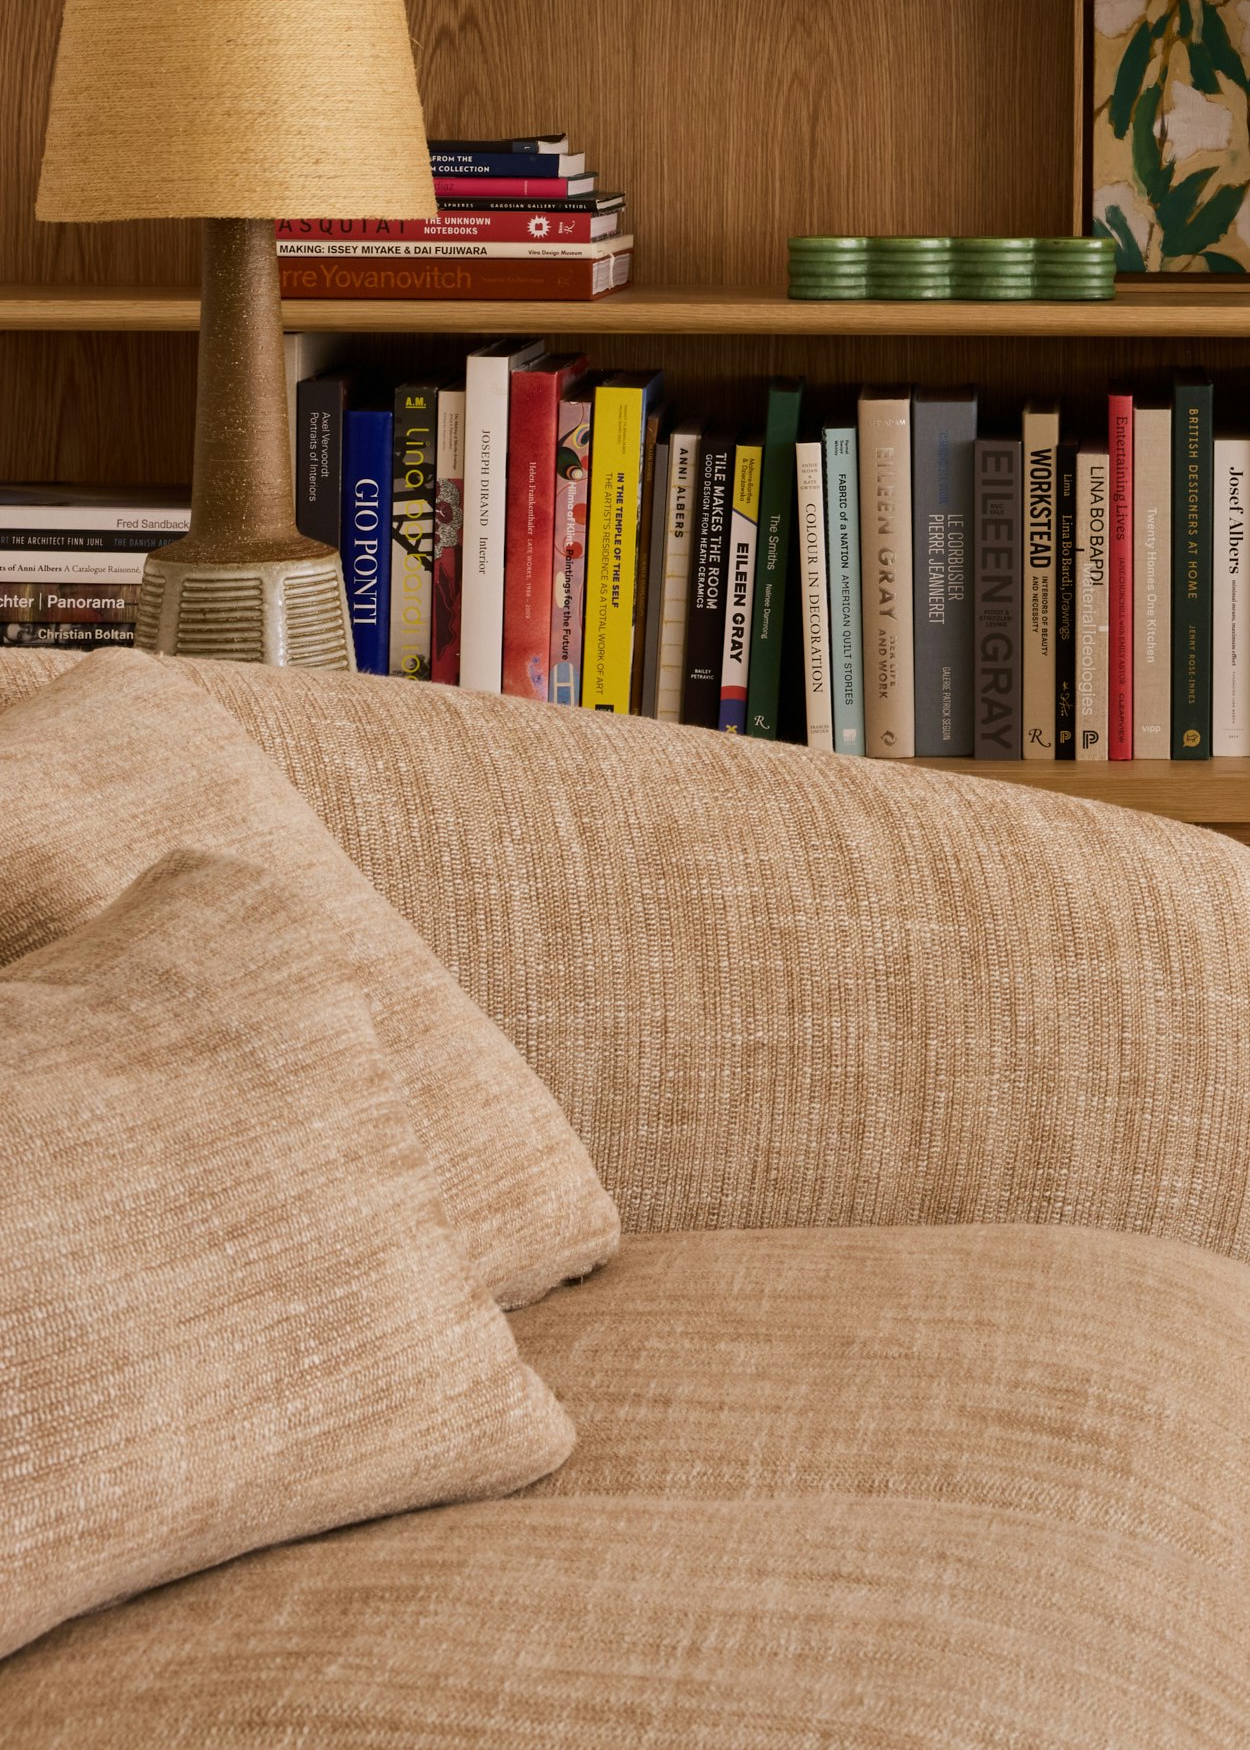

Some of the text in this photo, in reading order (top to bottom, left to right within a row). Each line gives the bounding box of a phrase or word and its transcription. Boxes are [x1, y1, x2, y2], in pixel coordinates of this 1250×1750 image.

[279, 245, 325, 254] MAKING:
[328, 246, 358, 254] ISSEY
[361, 246, 401, 254] MIYAKE
[414, 247, 432, 255] DAI
[435, 247, 487, 255] FUJIWARA
[424, 227, 478, 235] NOTEBOOKS
[320, 264, 471, 290] Yovanovitch
[320, 412, 330, 478] Axel Vervoordt
[480, 429, 491, 527] JOSEPH DIRAND
[1114, 416, 1129, 540] Entertaining Lives
[117, 519, 190, 530] Fred Sandback
[674, 448, 689, 539] ANNI ALBERS
[706, 453, 727, 610] TILE MAKES THE ROOM
[839, 474, 847, 509] FABRIC
[840, 512, 849, 521] of
[1030, 448, 1052, 568] WORKSTEAD
[1188, 408, 1199, 599] BRITISH DESIGNERS AT HOME
[1229, 467, 1245, 575] Josef Albers
[12, 537, 25, 545] THE
[28, 537, 65, 545] ARCHITECT
[87, 538, 104, 546] JUHL
[352, 479, 379, 626] GIO PONTI
[478, 537, 488, 575] Interior
[611, 472, 625, 609] IN THE TEMPLE OF THE SELF
[841, 533, 849, 569] NATION
[929, 514, 945, 625] PIERRE JEANNERET
[948, 514, 964, 601] LE CORBUSIER
[1145, 507, 1158, 663] Twenty Homes One Kitchen
[38, 629, 134, 640] Christian Boltan
[47, 595, 125, 609] Panorama
[730, 542, 750, 664] EILEEN GRAY
[805, 503, 824, 693] COLOUR IN DECORATION
